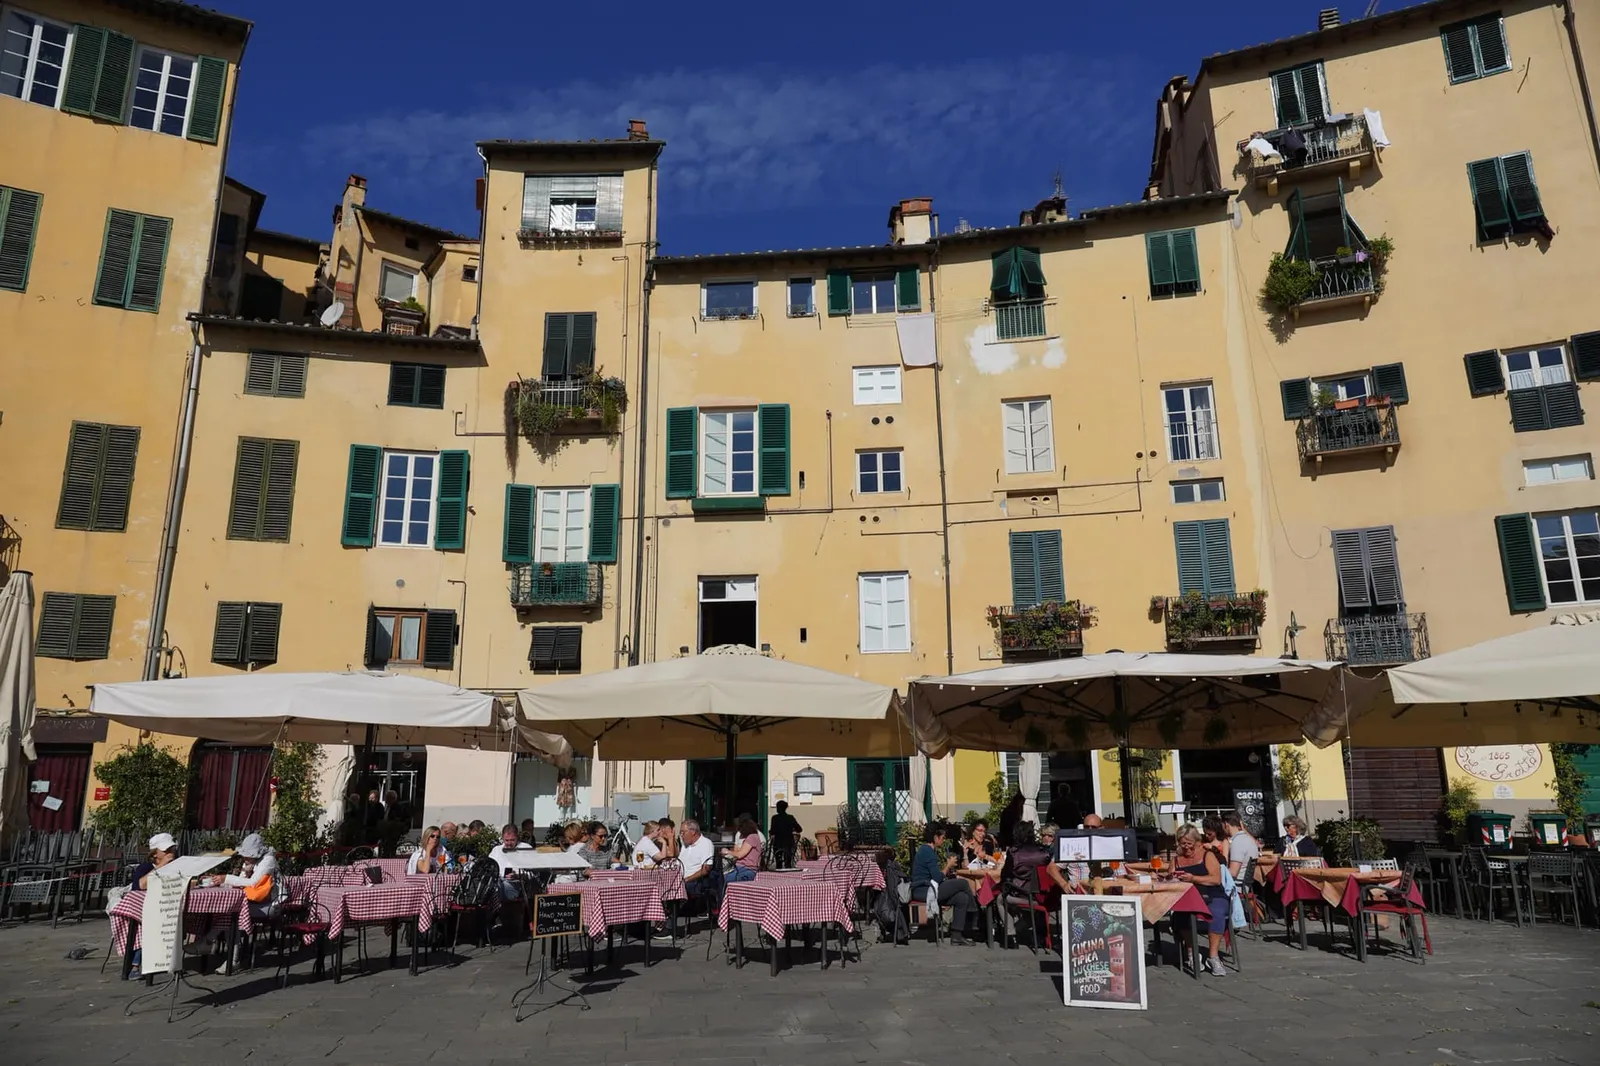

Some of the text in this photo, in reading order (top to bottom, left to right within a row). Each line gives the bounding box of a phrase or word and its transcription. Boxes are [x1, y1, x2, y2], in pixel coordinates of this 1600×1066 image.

[1488, 751, 1511, 761] 1865
[1490, 757, 1537, 779] Grotta
[537, 923, 575, 933] GLUTEN FREE
[1072, 938, 1104, 956] CUCINA
[1072, 951, 1098, 967] TIPICA
[1073, 960, 1109, 977] LUCCHESE
[1079, 983, 1101, 996] FOOD
